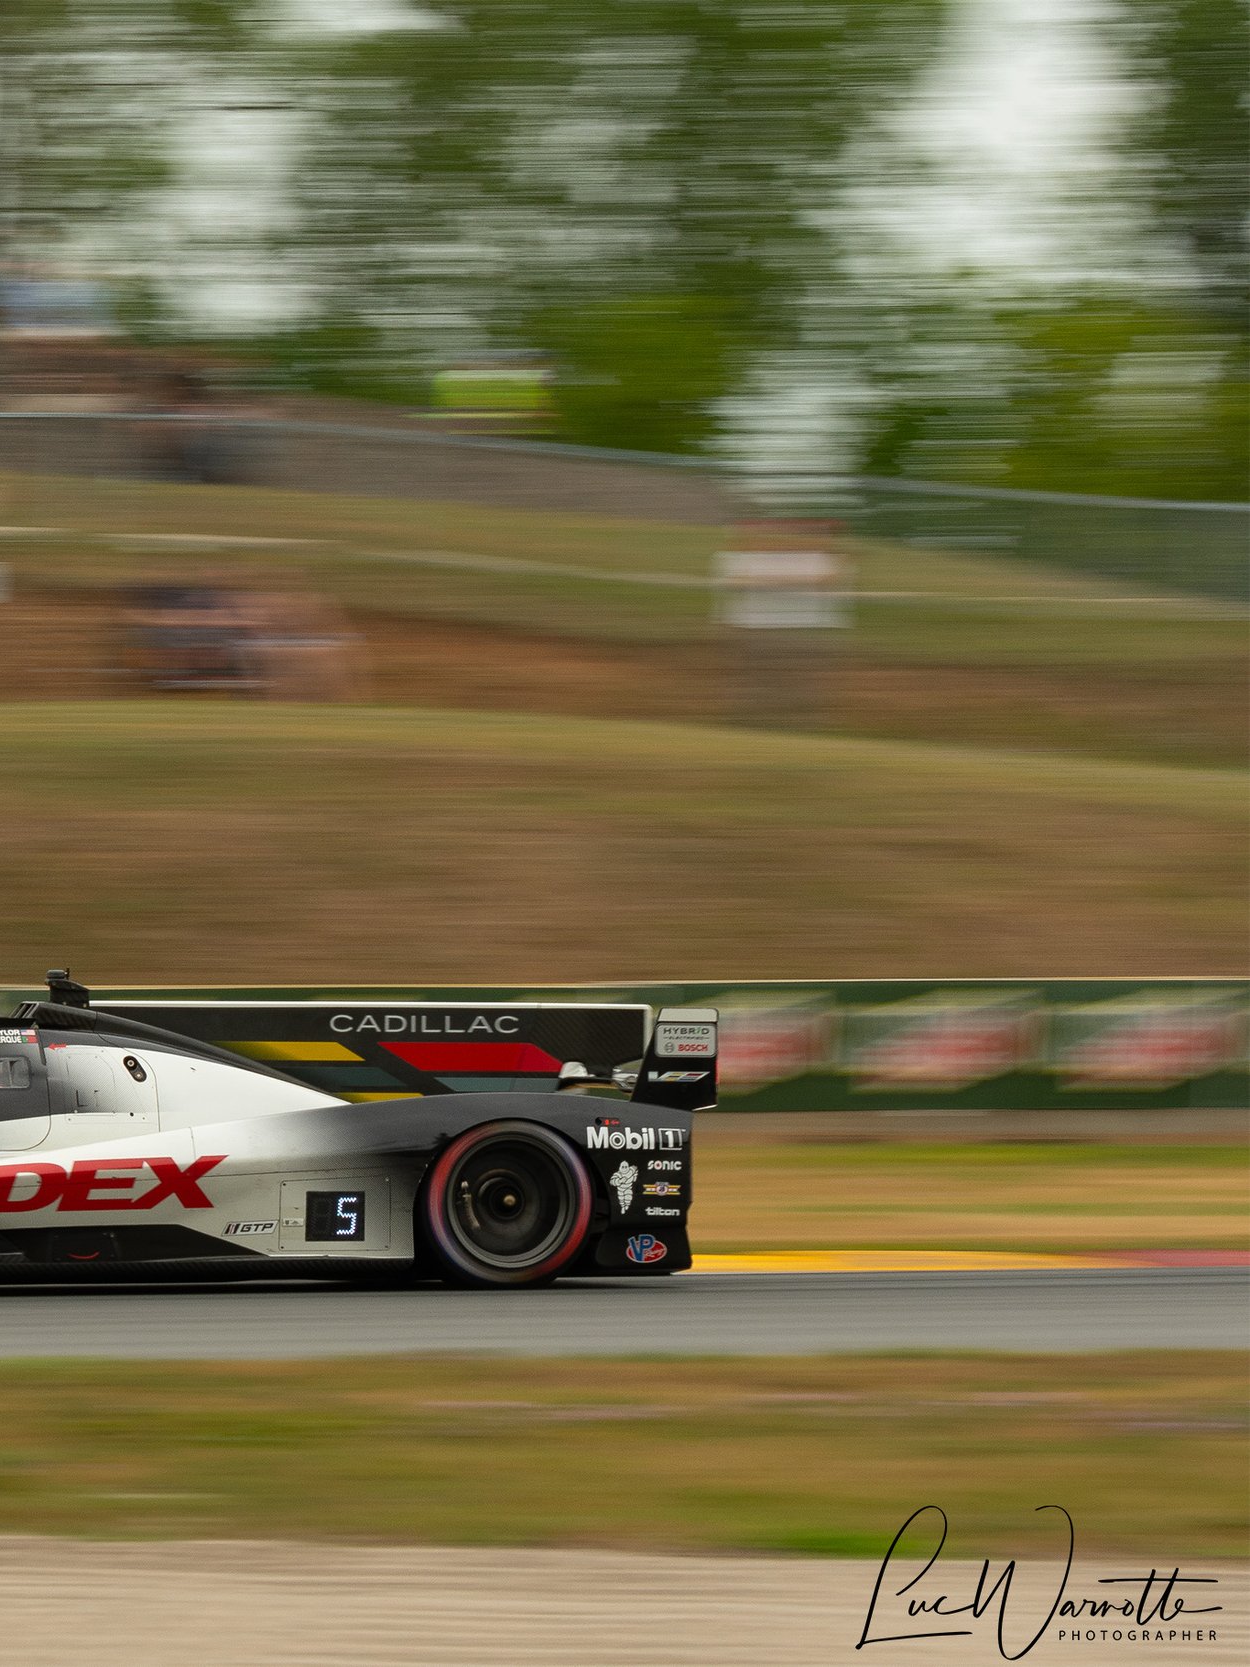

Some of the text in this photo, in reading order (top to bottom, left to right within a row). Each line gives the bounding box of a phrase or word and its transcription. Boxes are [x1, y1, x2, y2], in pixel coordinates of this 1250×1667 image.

[328, 1013, 521, 1034] CADILLAC
[677, 1043, 709, 1052] BOSCH
[586, 1126, 656, 1150] Mobil
[336, 1197, 357, 1235] 5
[240, 1222, 274, 1233] GTP
[628, 1234, 655, 1262] VP
